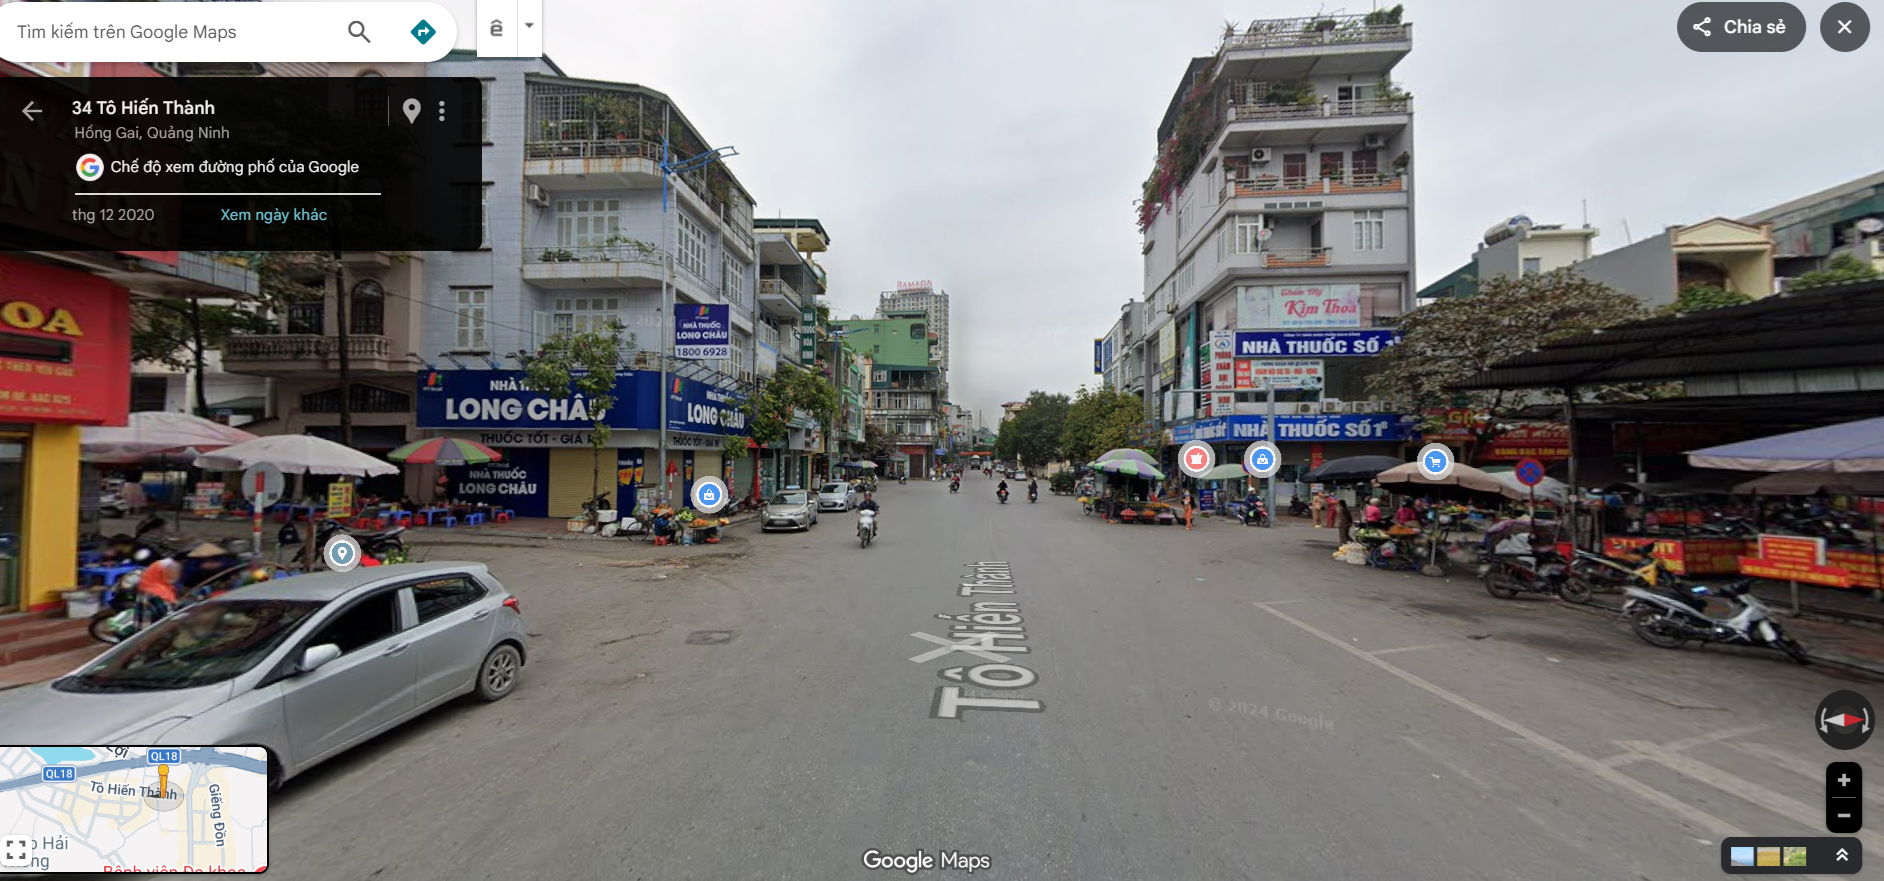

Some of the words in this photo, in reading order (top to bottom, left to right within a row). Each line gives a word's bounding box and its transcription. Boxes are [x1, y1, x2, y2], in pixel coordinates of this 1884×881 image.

[896, 279, 932, 289] RAMADA
[1284, 299, 1319, 318] Kim
[1322, 298, 1357, 314] Thoa
[683, 320, 698, 329] NHÀ
[698, 320, 721, 329] THUỐC
[677, 331, 701, 340] LONG
[702, 329, 728, 340] CHÂU
[677, 348, 701, 356] 1800
[703, 347, 728, 356] 6928
[1242, 337, 1281, 354] NHÀ
[1285, 335, 1348, 354] THUỐC
[1353, 335, 1380, 354] SỐ
[490, 377, 518, 392] NHÀ
[445, 397, 523, 421] LONG
[687, 402, 718, 426] LONG
[719, 407, 745, 430] CHÂU
[1233, 420, 1269, 437] NHÀ
[1277, 418, 1340, 437] THUỐC
[1344, 418, 1374, 437] SỐ
[481, 430, 523, 443] THUỐC
[527, 430, 550, 443] TỐT
[560, 430, 583, 444] GIÁ
[469, 467, 491, 479] NHÀ
[493, 466, 527, 479] THUỐC
[458, 483, 496, 494] LONG
[498, 481, 537, 494] CHÂU
